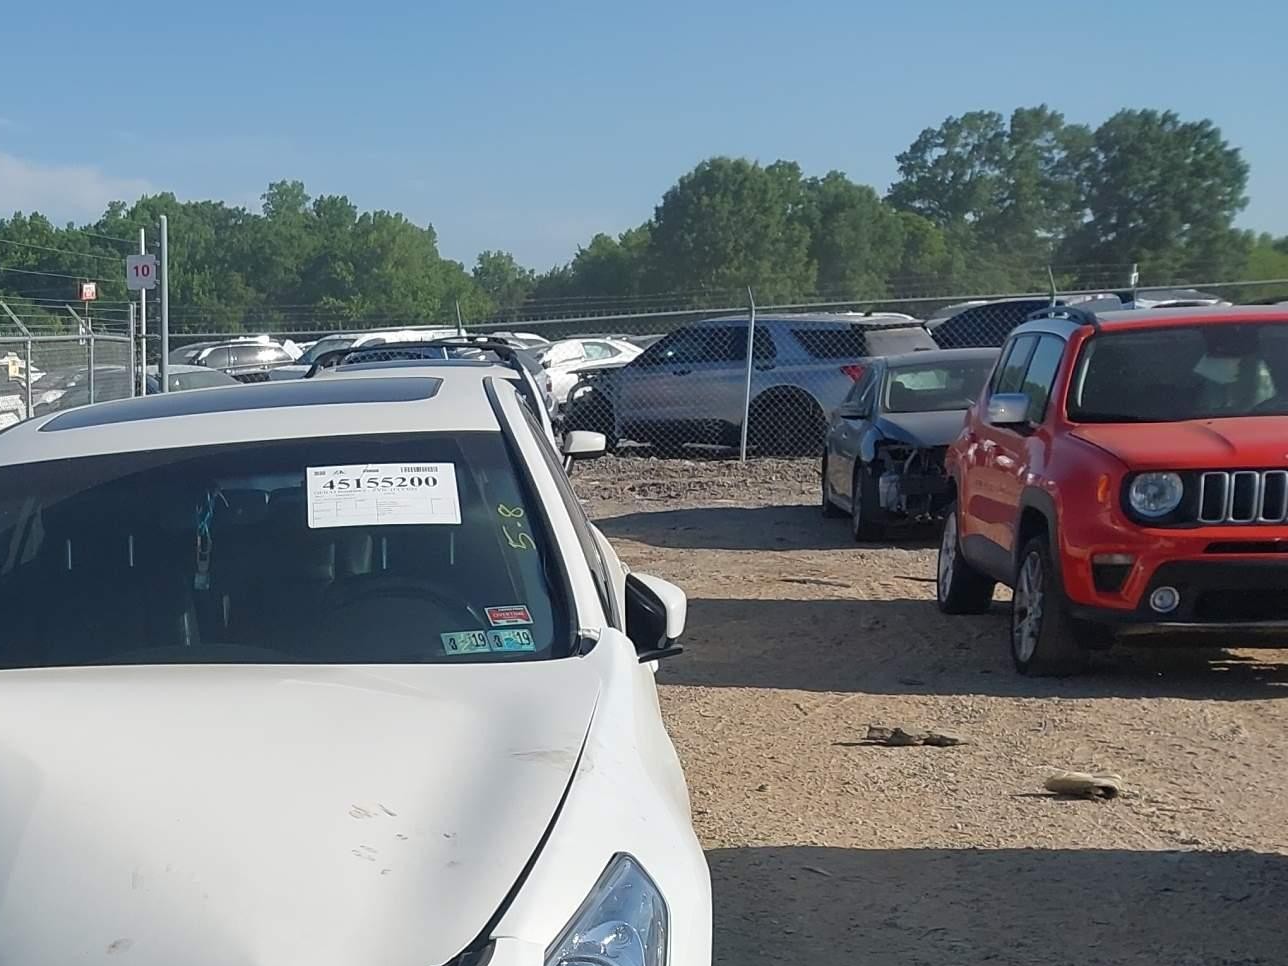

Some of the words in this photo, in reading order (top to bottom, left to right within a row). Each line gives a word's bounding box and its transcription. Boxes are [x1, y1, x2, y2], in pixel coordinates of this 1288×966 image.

[133, 264, 150, 278] 10
[322, 475, 438, 490] 45155200
[448, 637, 458, 651] 3
[472, 632, 487, 648] 19
[493, 634, 503, 648] 3
[516, 631, 531, 647] 19
